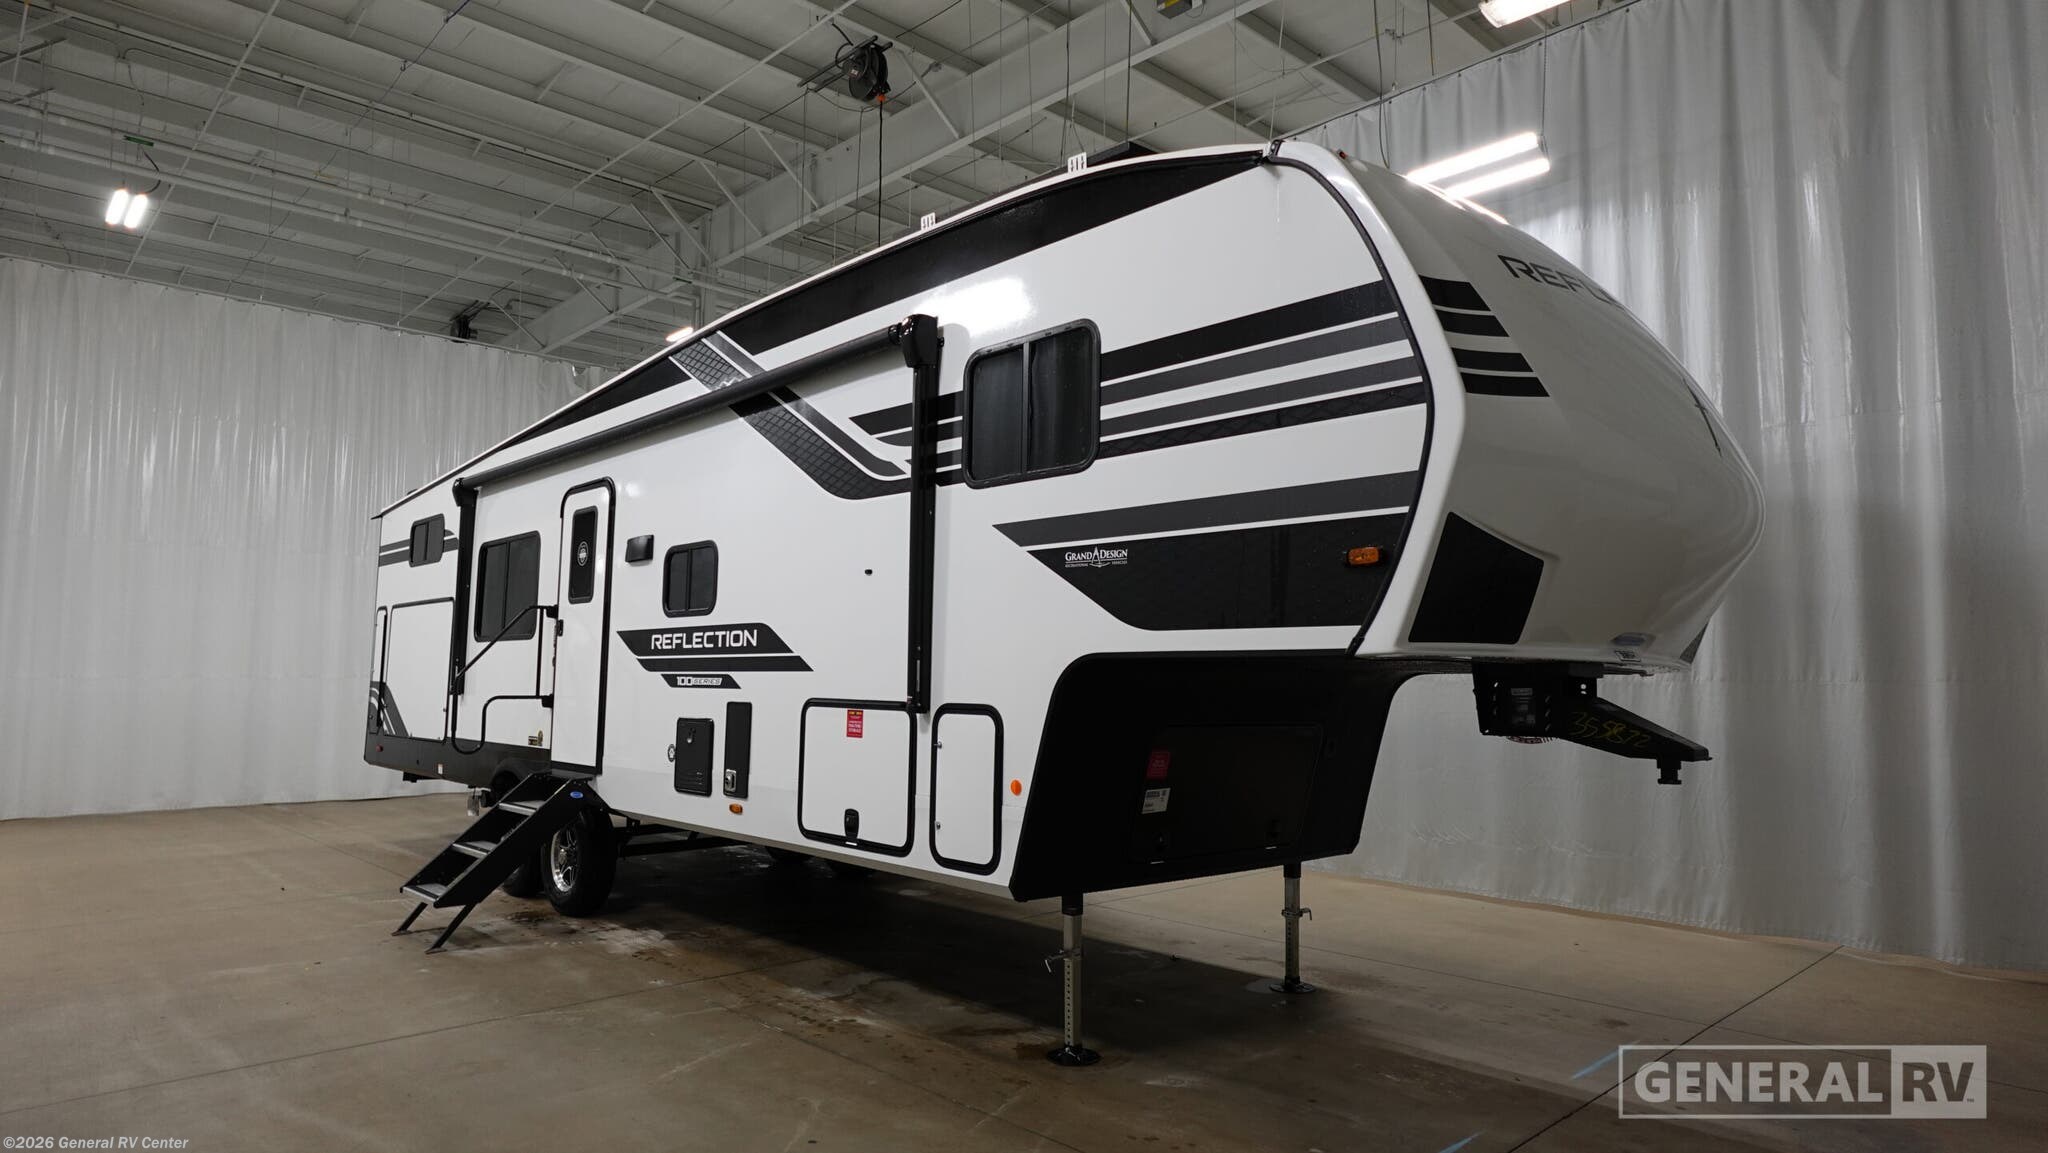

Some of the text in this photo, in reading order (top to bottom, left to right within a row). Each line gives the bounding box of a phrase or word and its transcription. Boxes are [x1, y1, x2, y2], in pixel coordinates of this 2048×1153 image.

[1065, 549, 1128, 561] GRAND DESIGN
[651, 630, 757, 650] REFLECTION
[677, 676, 693, 686] 100
